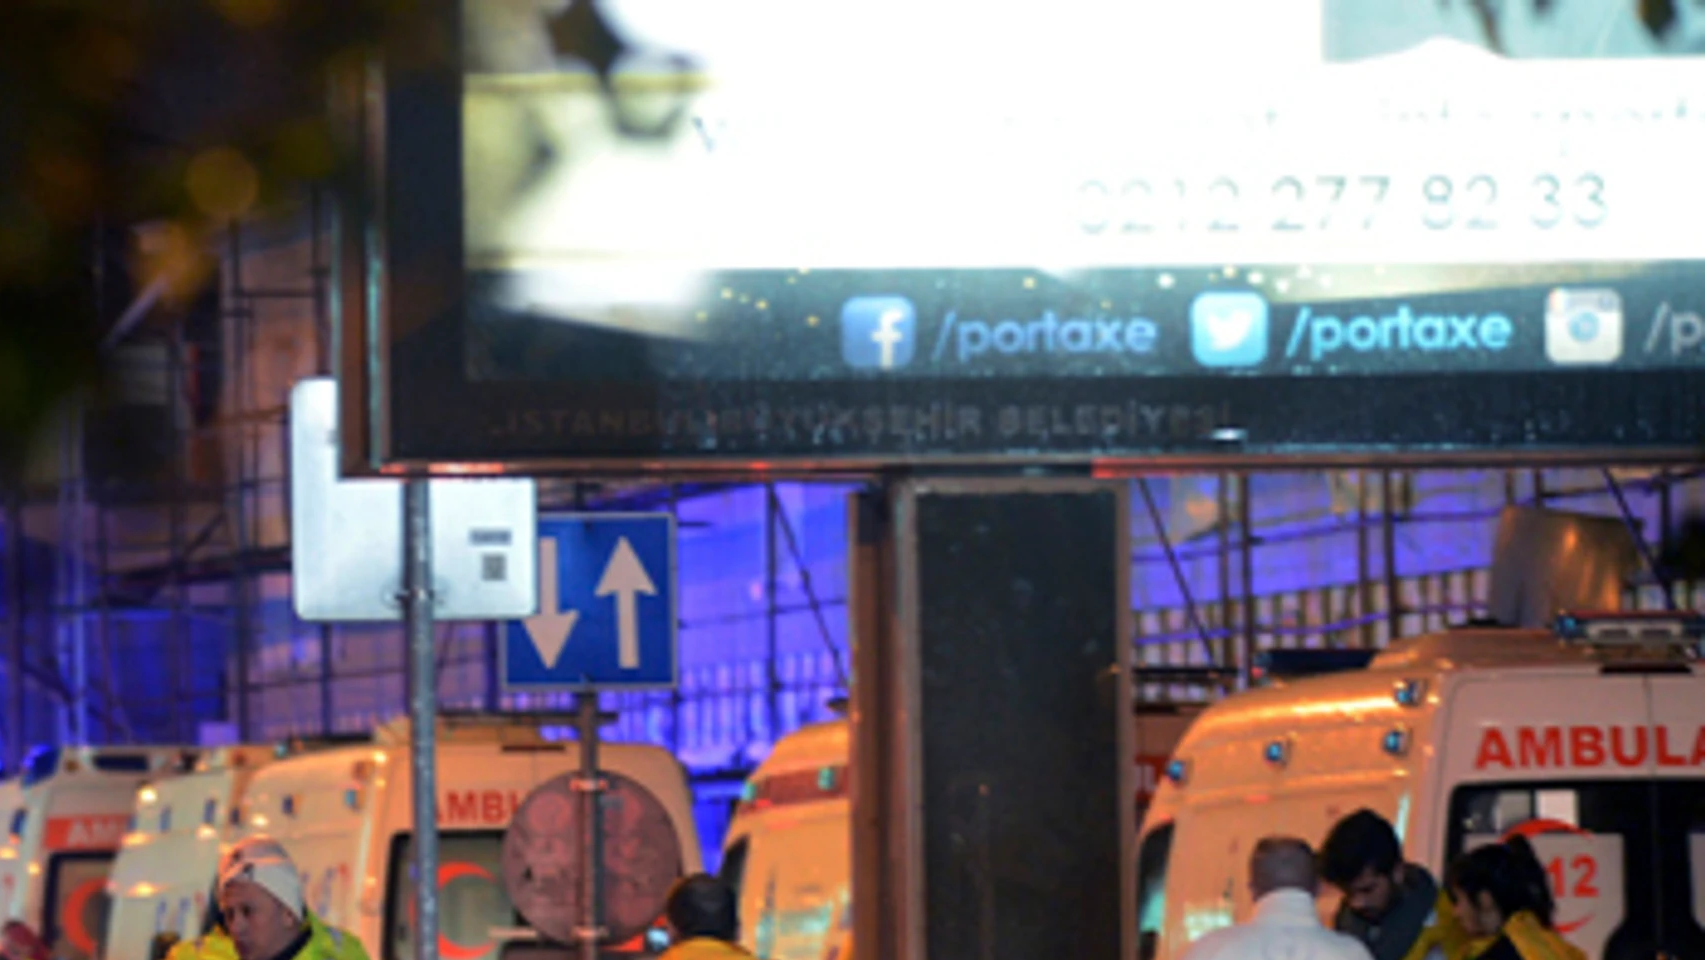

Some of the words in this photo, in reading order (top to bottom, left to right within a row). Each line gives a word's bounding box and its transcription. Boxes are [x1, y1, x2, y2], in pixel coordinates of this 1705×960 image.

[1270, 173, 1390, 231] 277
[1422, 172, 1498, 231] 82
[1530, 171, 1607, 229] 33
[931, 309, 1158, 363] /portaxe
[1285, 305, 1513, 360] /portaxe
[1548, 855, 1599, 898] 12
